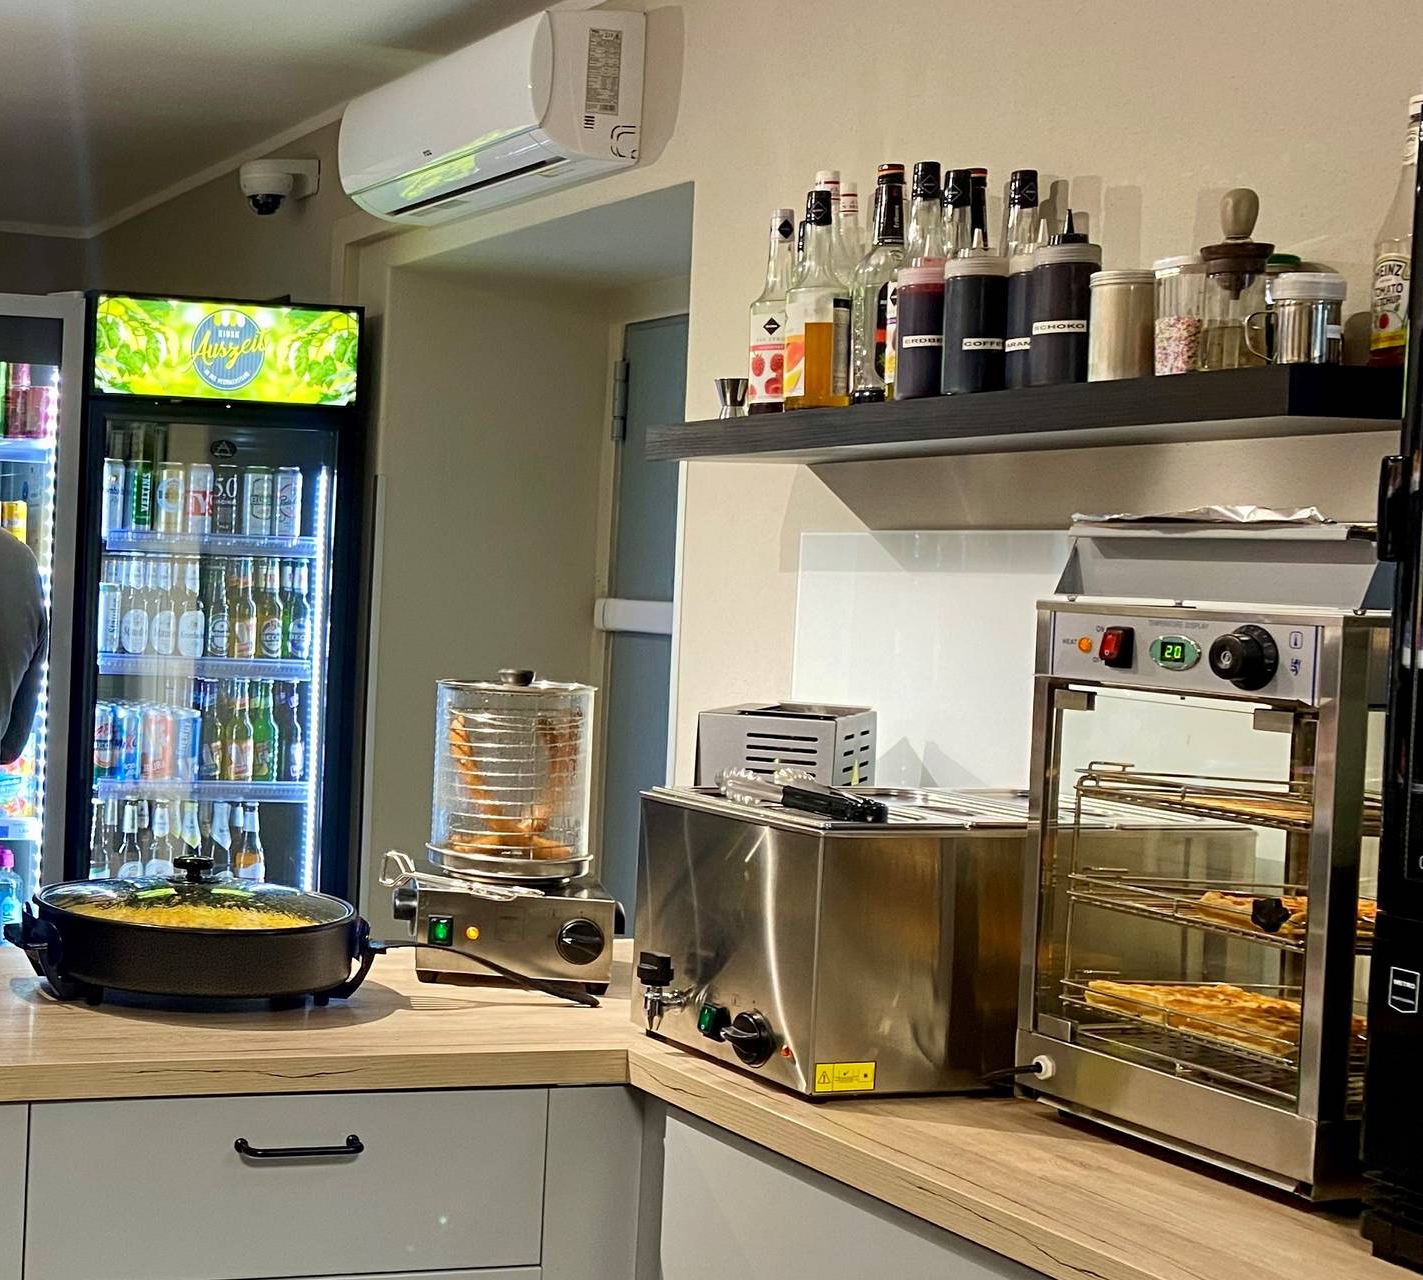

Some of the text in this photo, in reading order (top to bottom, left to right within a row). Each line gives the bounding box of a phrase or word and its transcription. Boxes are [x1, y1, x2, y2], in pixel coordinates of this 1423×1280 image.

[1375, 282, 1404, 295] OMATO
[1033, 323, 1085, 332] SCHOKO
[903, 336, 943, 345] ERDBE
[963, 339, 1004, 348] COFFE
[185, 328, 270, 371] Auszeit
[140, 472, 152, 513] VELTINS
[214, 473, 238, 499] 5,0
[1164, 645, 1182, 659] 20
